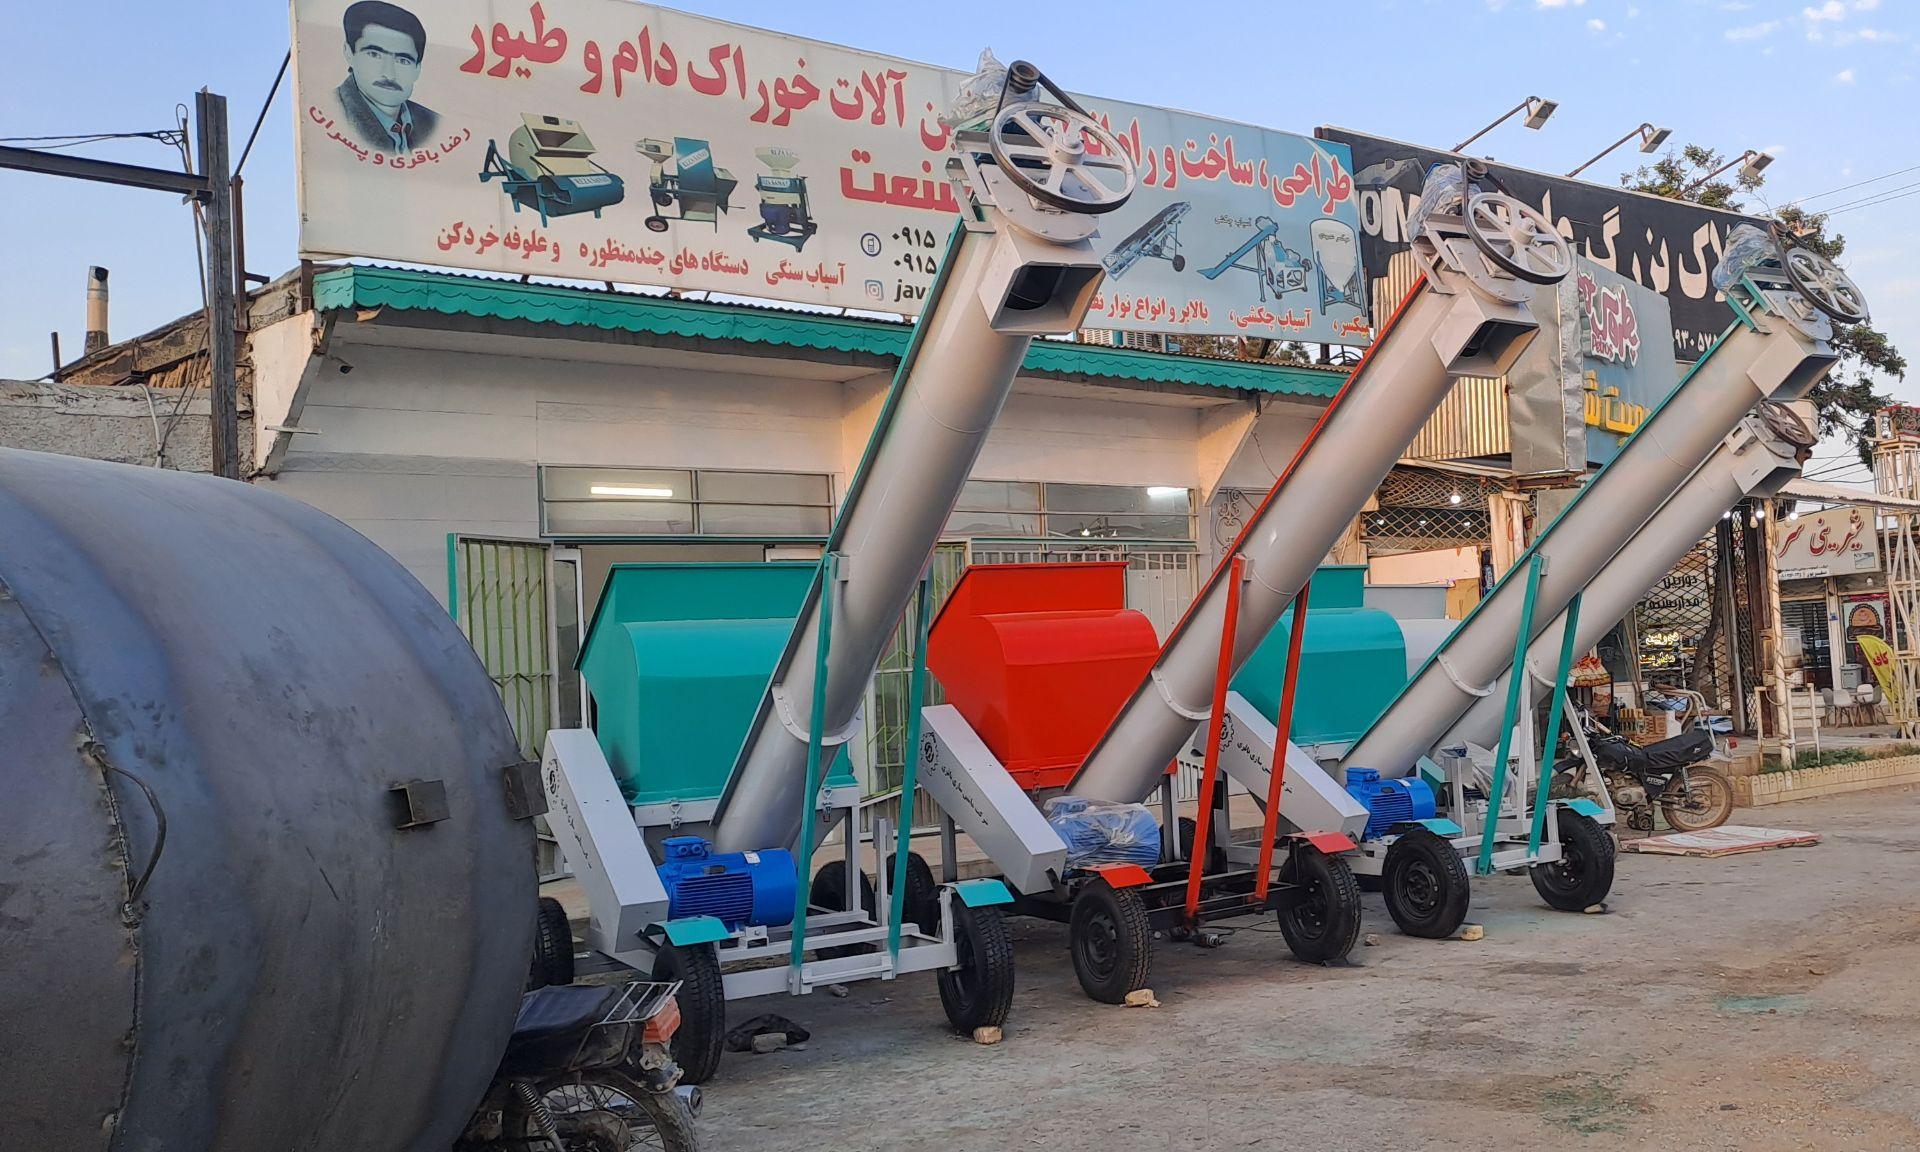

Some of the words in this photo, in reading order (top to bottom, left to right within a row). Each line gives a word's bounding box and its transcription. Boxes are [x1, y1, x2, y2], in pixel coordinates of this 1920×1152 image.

[460, 1, 567, 78] طیور
[580, 40, 602, 94] و
[613, 25, 677, 98] دام
[687, 44, 820, 126] خوراک
[830, 69, 907, 128] آلات
[309, 106, 368, 161] پسران
[440, 128, 471, 153] رضا
[373, 153, 384, 164] و
[390, 150, 439, 168] باقری
[1163, 147, 1177, 188] و
[1180, 134, 1253, 184] ساخت
[504, 226, 547, 260] علوفه
[551, 241, 561, 263] و
[670, 247, 699, 276] های
[702, 249, 749, 276] دستگاه
[765, 258, 803, 285] سنگی
[806, 261, 845, 290] آسیاب
[894, 279, 931, 302] jav
[1107, 293, 1131, 319] نوار
[1135, 296, 1166, 321] انواع
[1169, 304, 1176, 322] و
[1278, 307, 1312, 330] آسیاب
[1673, 328, 1695, 350] ۹۳۰
[1774, 524, 1806, 559] سر
